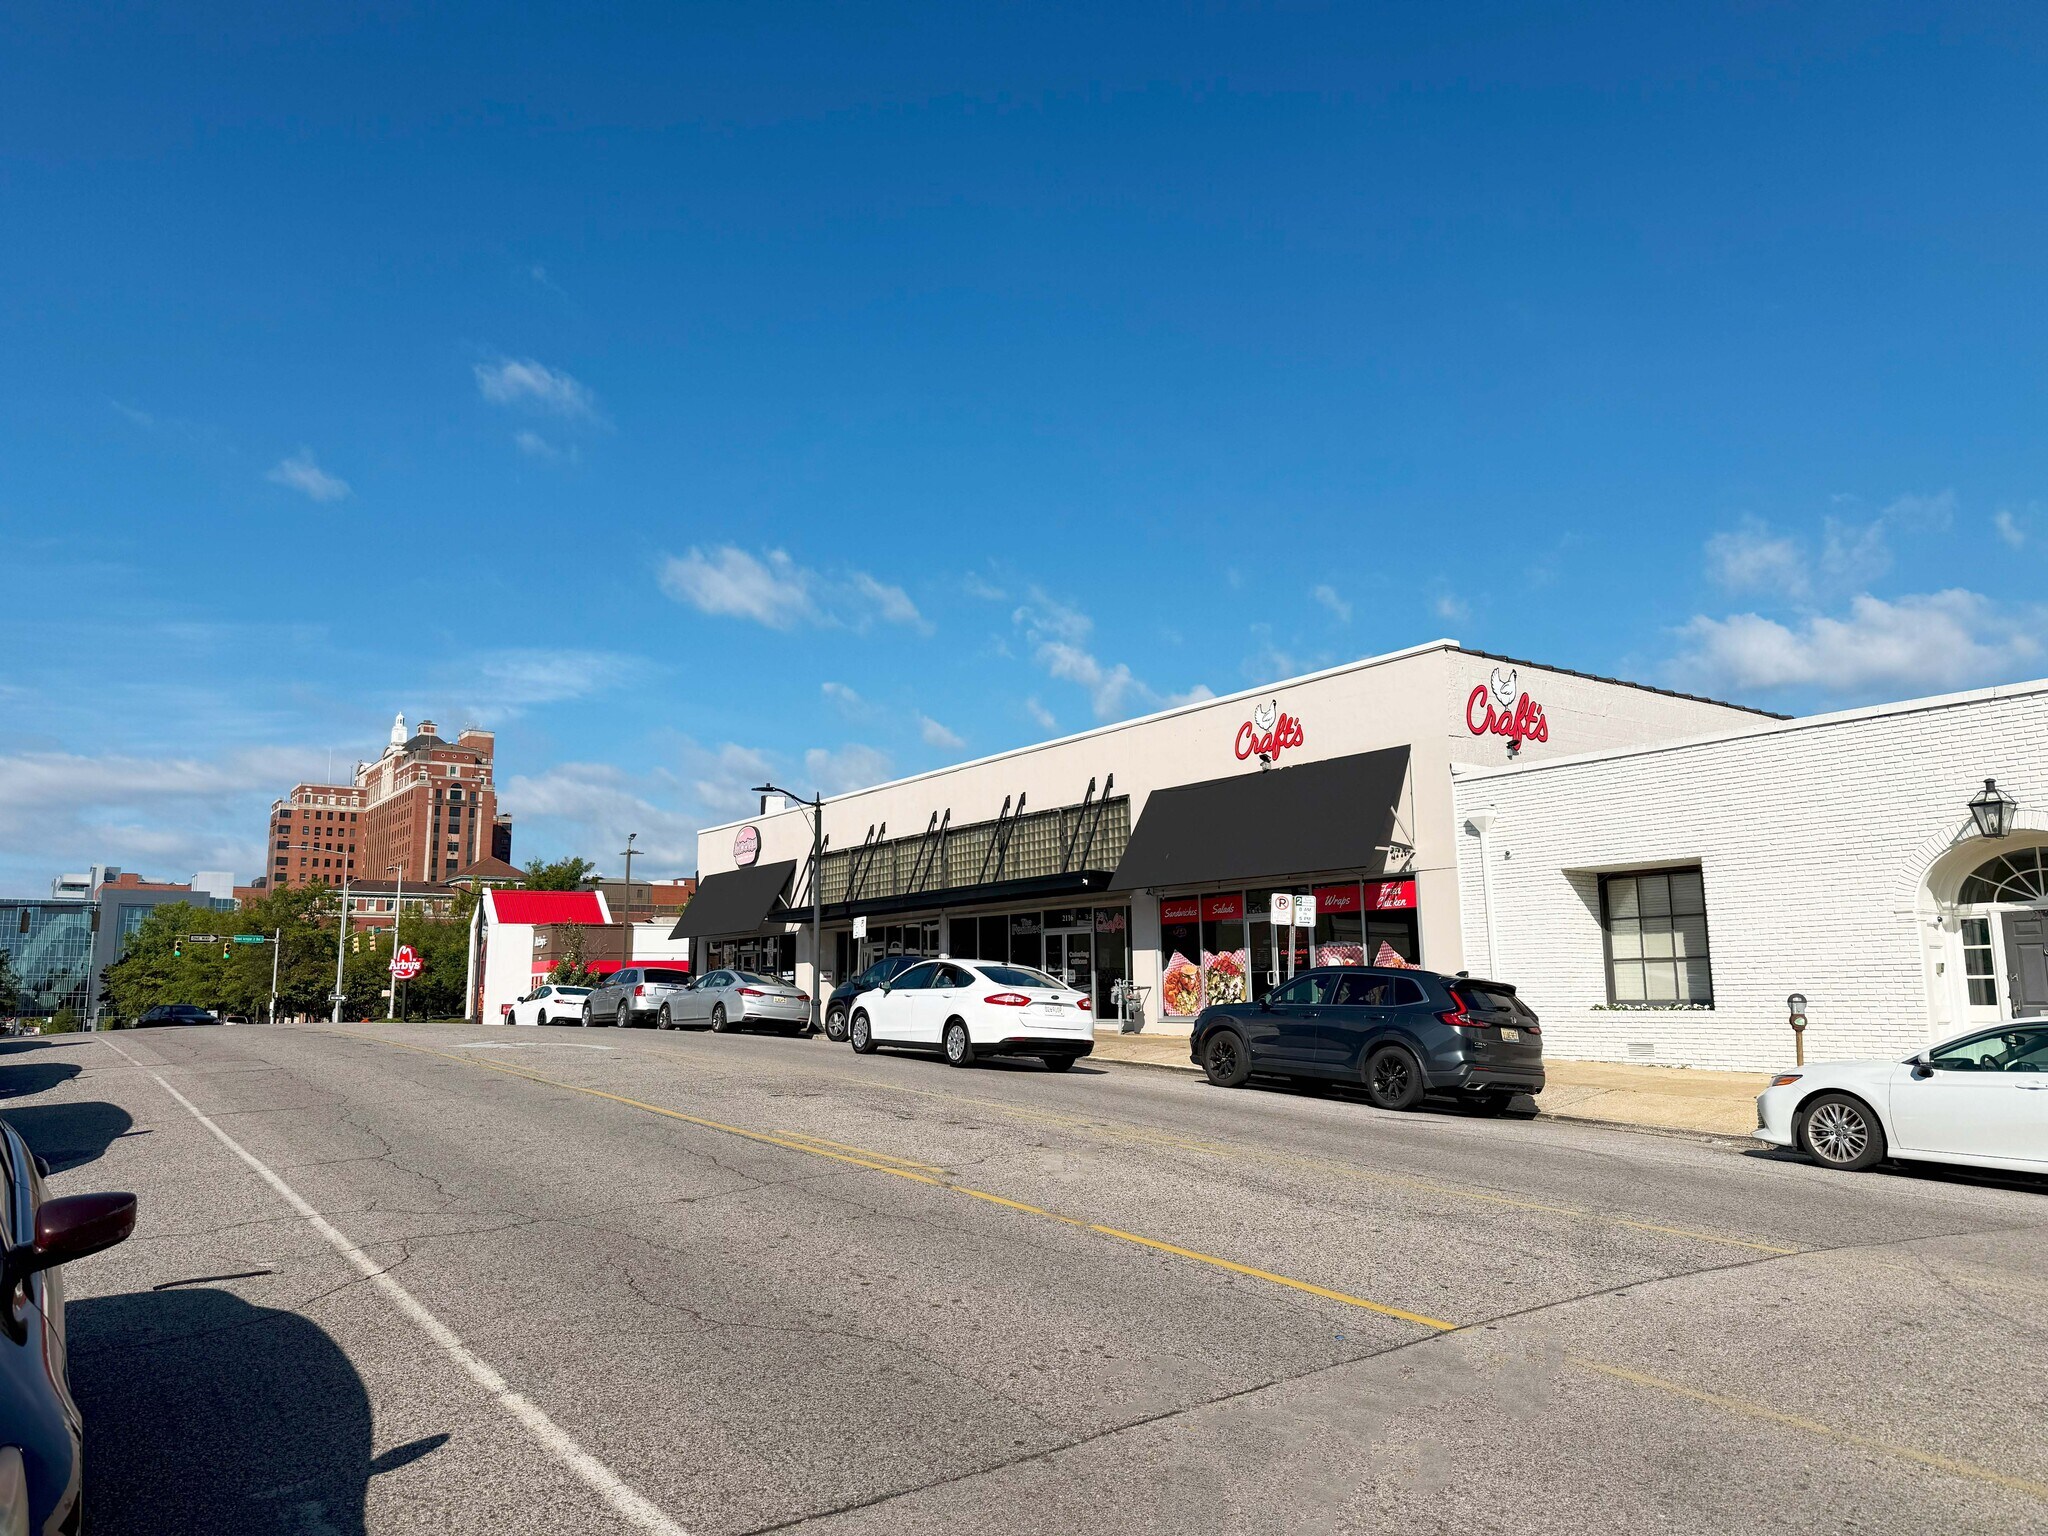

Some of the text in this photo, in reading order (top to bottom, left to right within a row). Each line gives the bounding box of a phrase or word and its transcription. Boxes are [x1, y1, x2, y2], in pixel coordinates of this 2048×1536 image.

[1466, 684, 1549, 752] Craft's
[1235, 712, 1304, 761] Craft's
[1380, 881, 1403, 895] Fried
[1212, 902, 1235, 914] Salads
[1325, 894, 1351, 909] Wraps
[1376, 895, 1407, 909] Chicken
[1164, 906, 1198, 918] Sandwiches
[388, 958, 421, 972] Arby's
